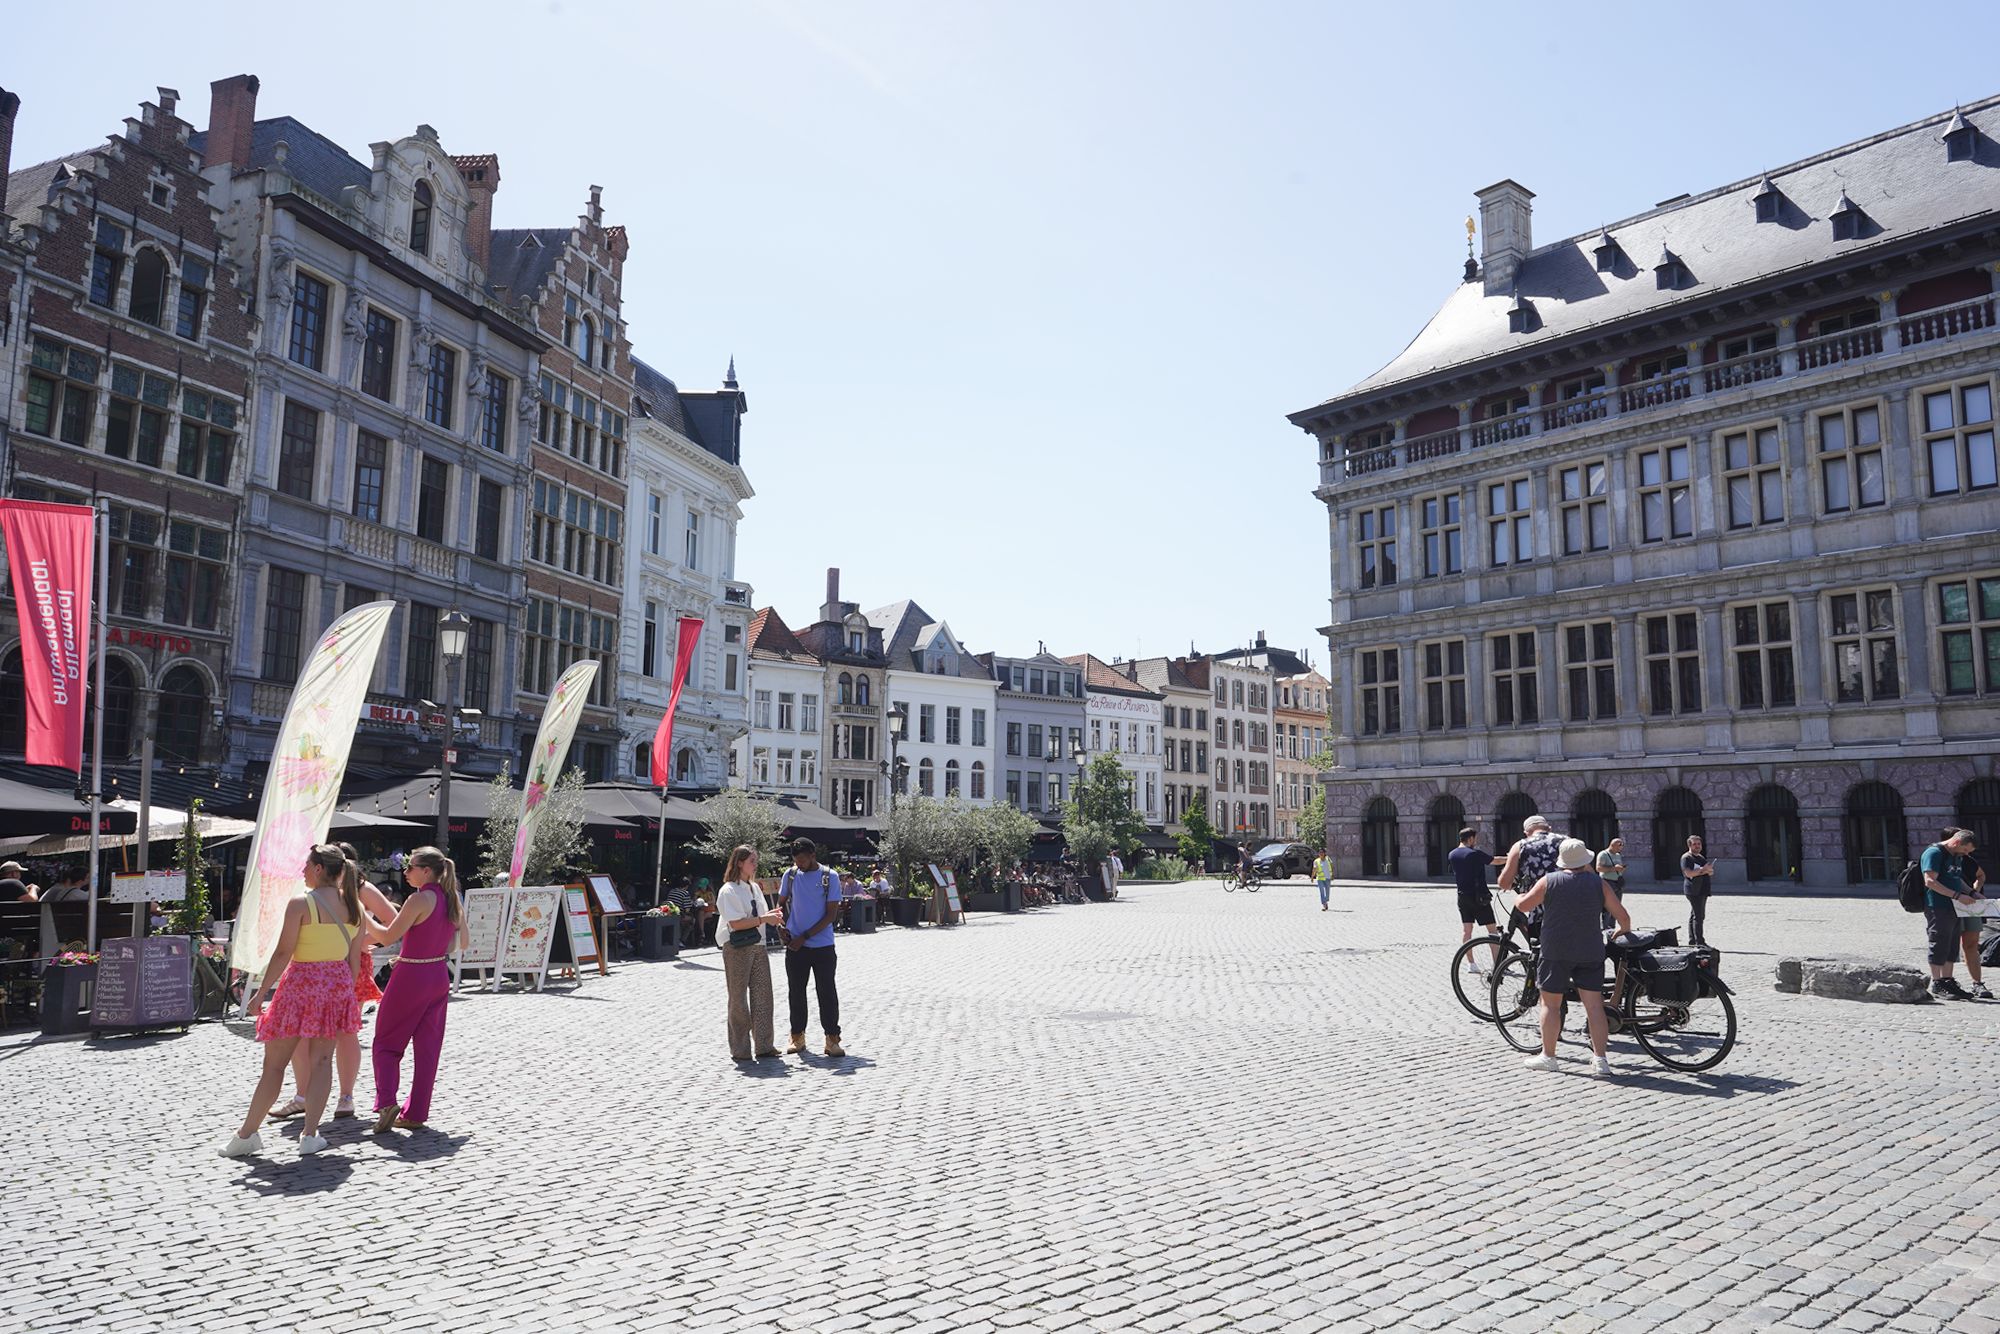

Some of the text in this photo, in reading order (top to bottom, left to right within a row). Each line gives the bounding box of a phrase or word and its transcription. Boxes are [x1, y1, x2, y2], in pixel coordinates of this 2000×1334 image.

[128, 629, 192, 654] PATIO
[370, 705, 416, 724] BELLA
[71, 815, 111, 831] Duel
